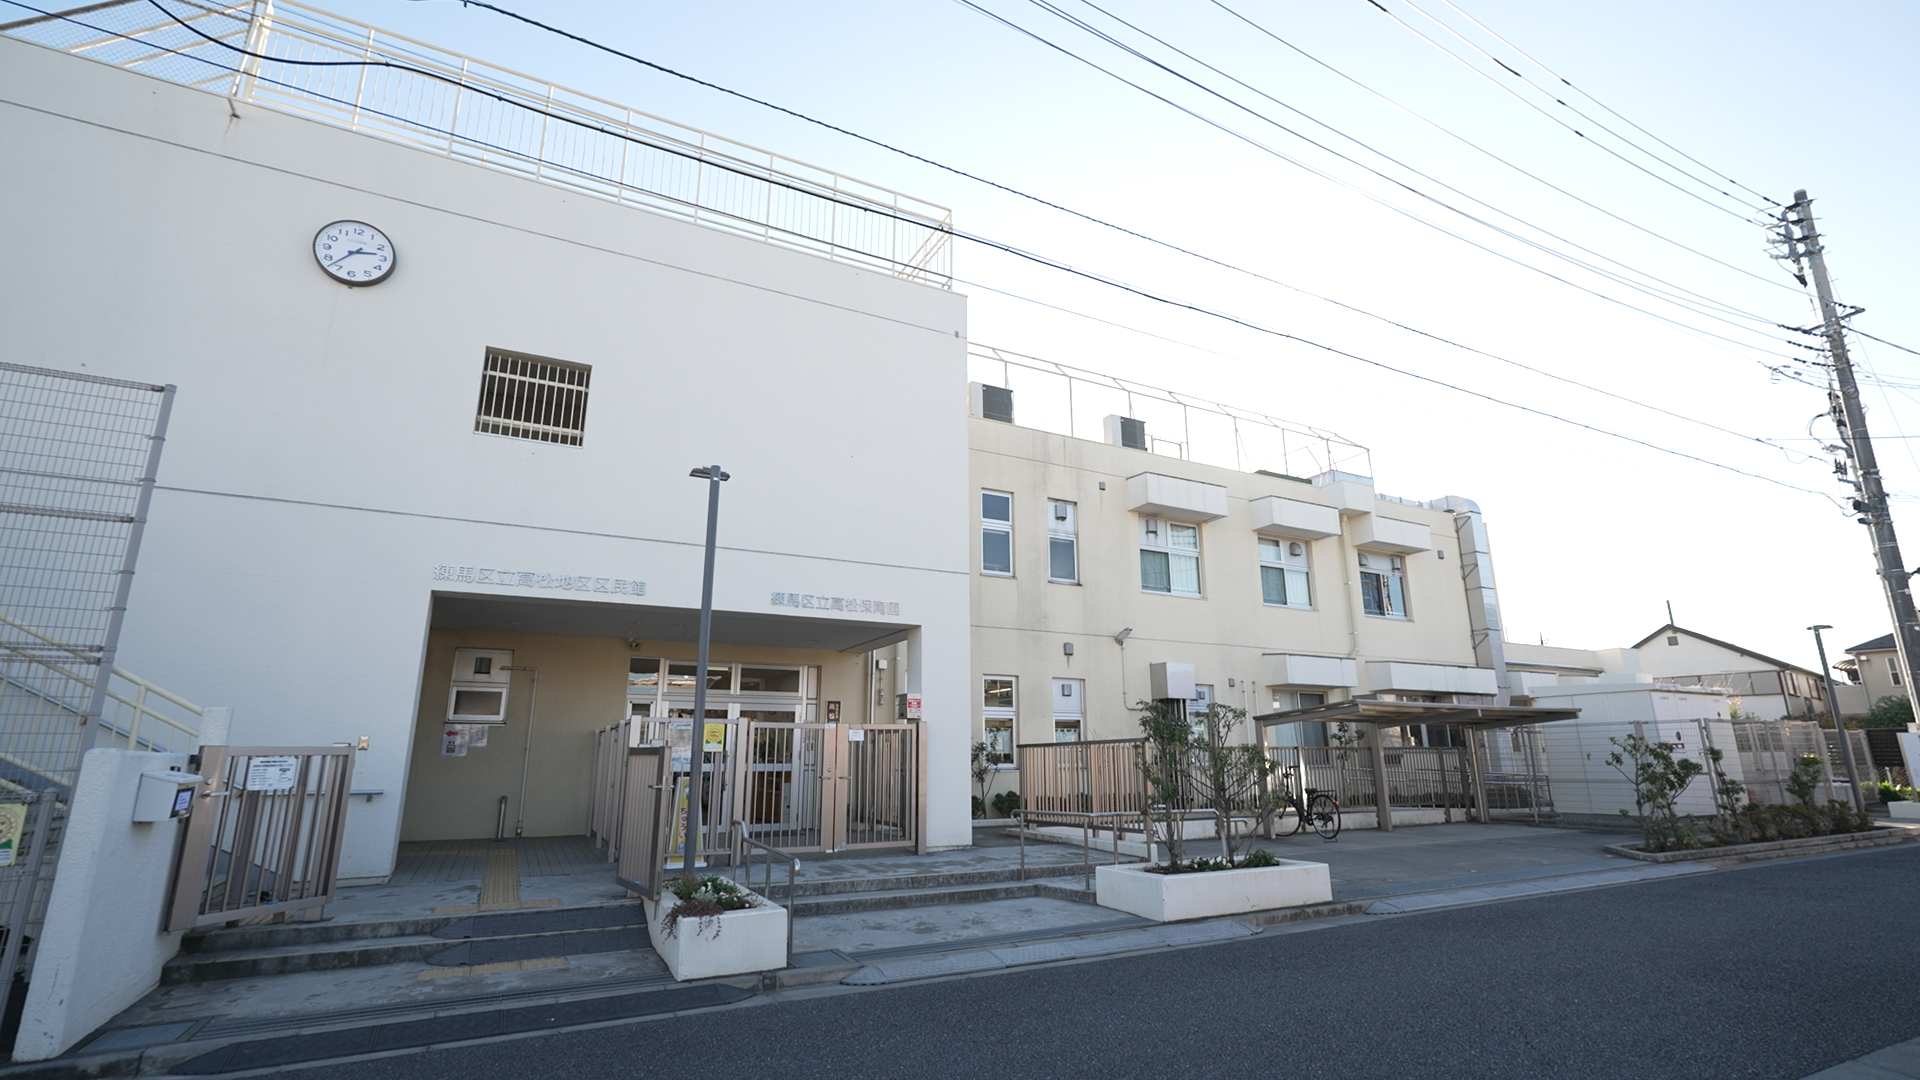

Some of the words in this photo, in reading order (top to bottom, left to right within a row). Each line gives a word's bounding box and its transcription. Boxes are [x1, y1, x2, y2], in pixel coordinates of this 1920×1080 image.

[353, 228, 365, 236] 12
[327, 234, 338, 242] 10
[347, 270, 356, 278] 6
[433, 563, 647, 596] 練馬区立高松地区区民館
[770, 591, 900, 616] 練馬区立高松保育園
